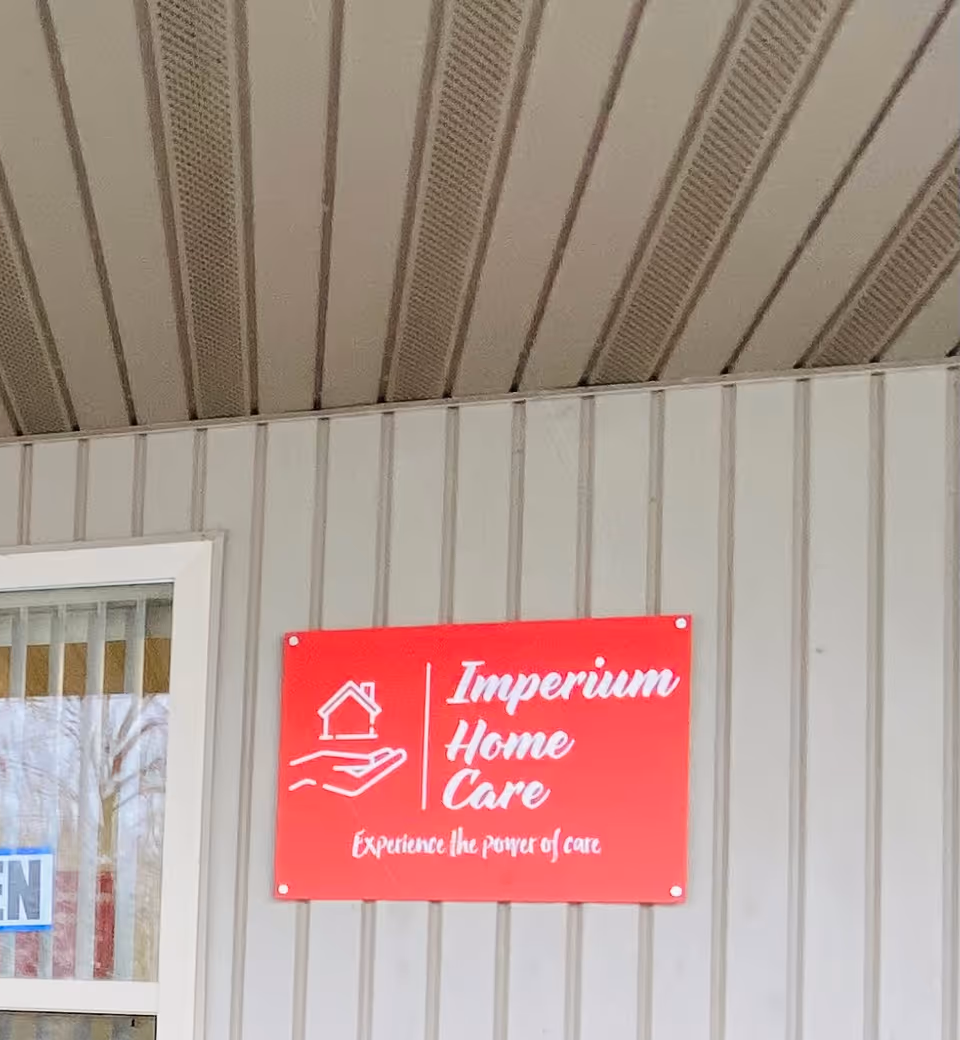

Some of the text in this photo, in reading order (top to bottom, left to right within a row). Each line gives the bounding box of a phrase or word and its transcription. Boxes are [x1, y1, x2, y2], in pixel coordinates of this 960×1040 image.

[446, 656, 680, 714] Imperium
[445, 719, 575, 765] Home
[443, 768, 551, 809] Care
[352, 827, 601, 863] Experience the power of care
